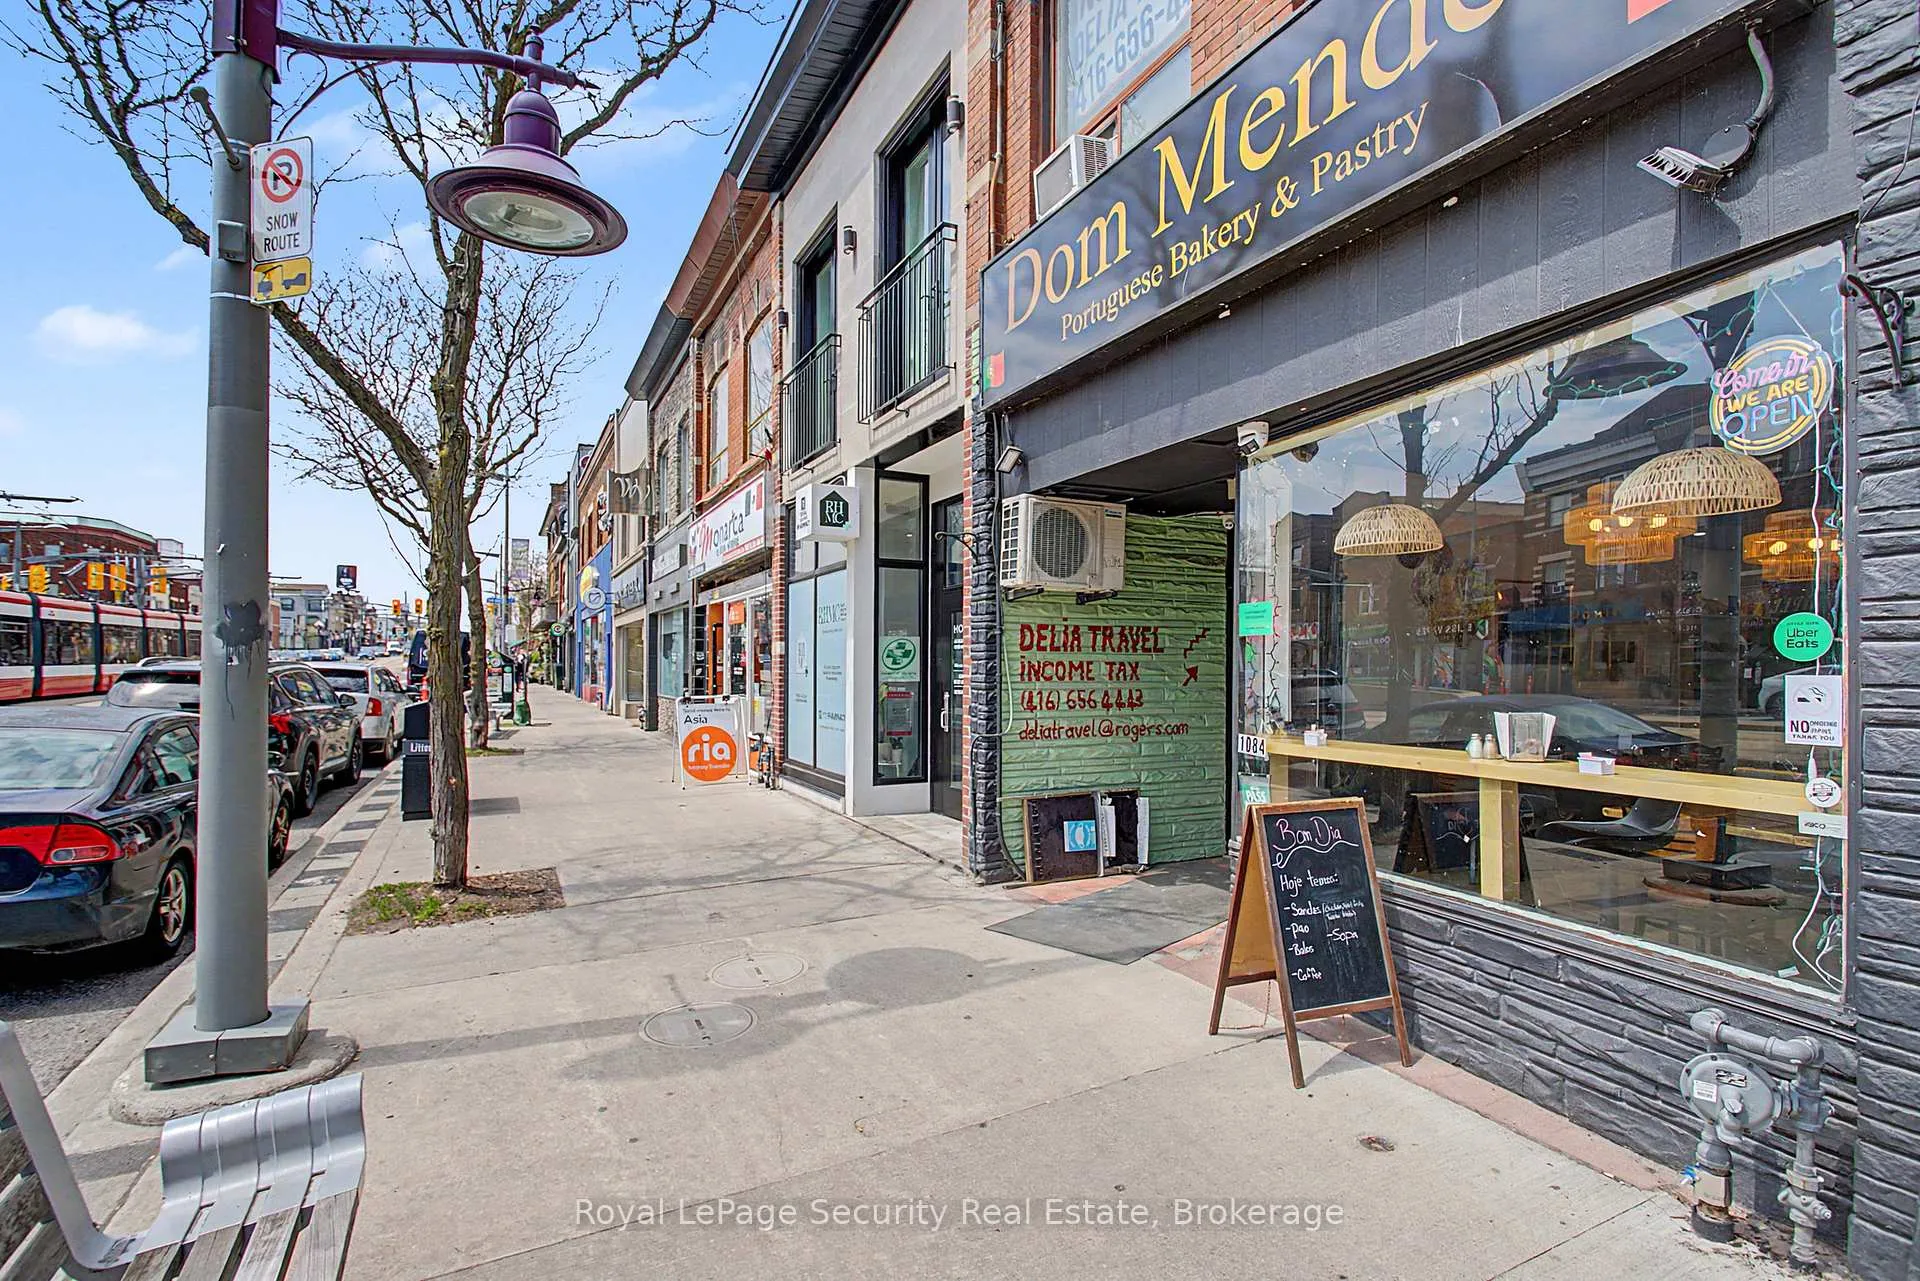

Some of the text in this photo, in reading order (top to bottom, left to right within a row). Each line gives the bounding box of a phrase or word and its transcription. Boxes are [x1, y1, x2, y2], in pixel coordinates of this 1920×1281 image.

[266, 211, 298, 232] SNOW
[1060, 100, 1429, 341] Portuguese Bakery & Pastry
[264, 233, 300, 253] ROUTE
[1004, 201, 1131, 335] Dom
[1725, 375, 1809, 413] WE ARE
[1722, 389, 1814, 438] OPEN
[825, 500, 844, 514] RH
[1088, 625, 1164, 653] TRAVEL
[1786, 638, 1819, 649] Eats
[1787, 628, 1818, 638] Uber
[1105, 661, 1140, 681] TAX
[1020, 689, 1060, 713] (416)
[1066, 689, 1097, 710] 656
[684, 714, 708, 725] Asia
[1790, 720, 1810, 733] NO
[688, 733, 731, 763] ria
[1240, 735, 1265, 755] 1084
[1245, 789, 1266, 803] PASS
[1310, 816, 1342, 847] Dia
[1279, 874, 1303, 897] Hoje
